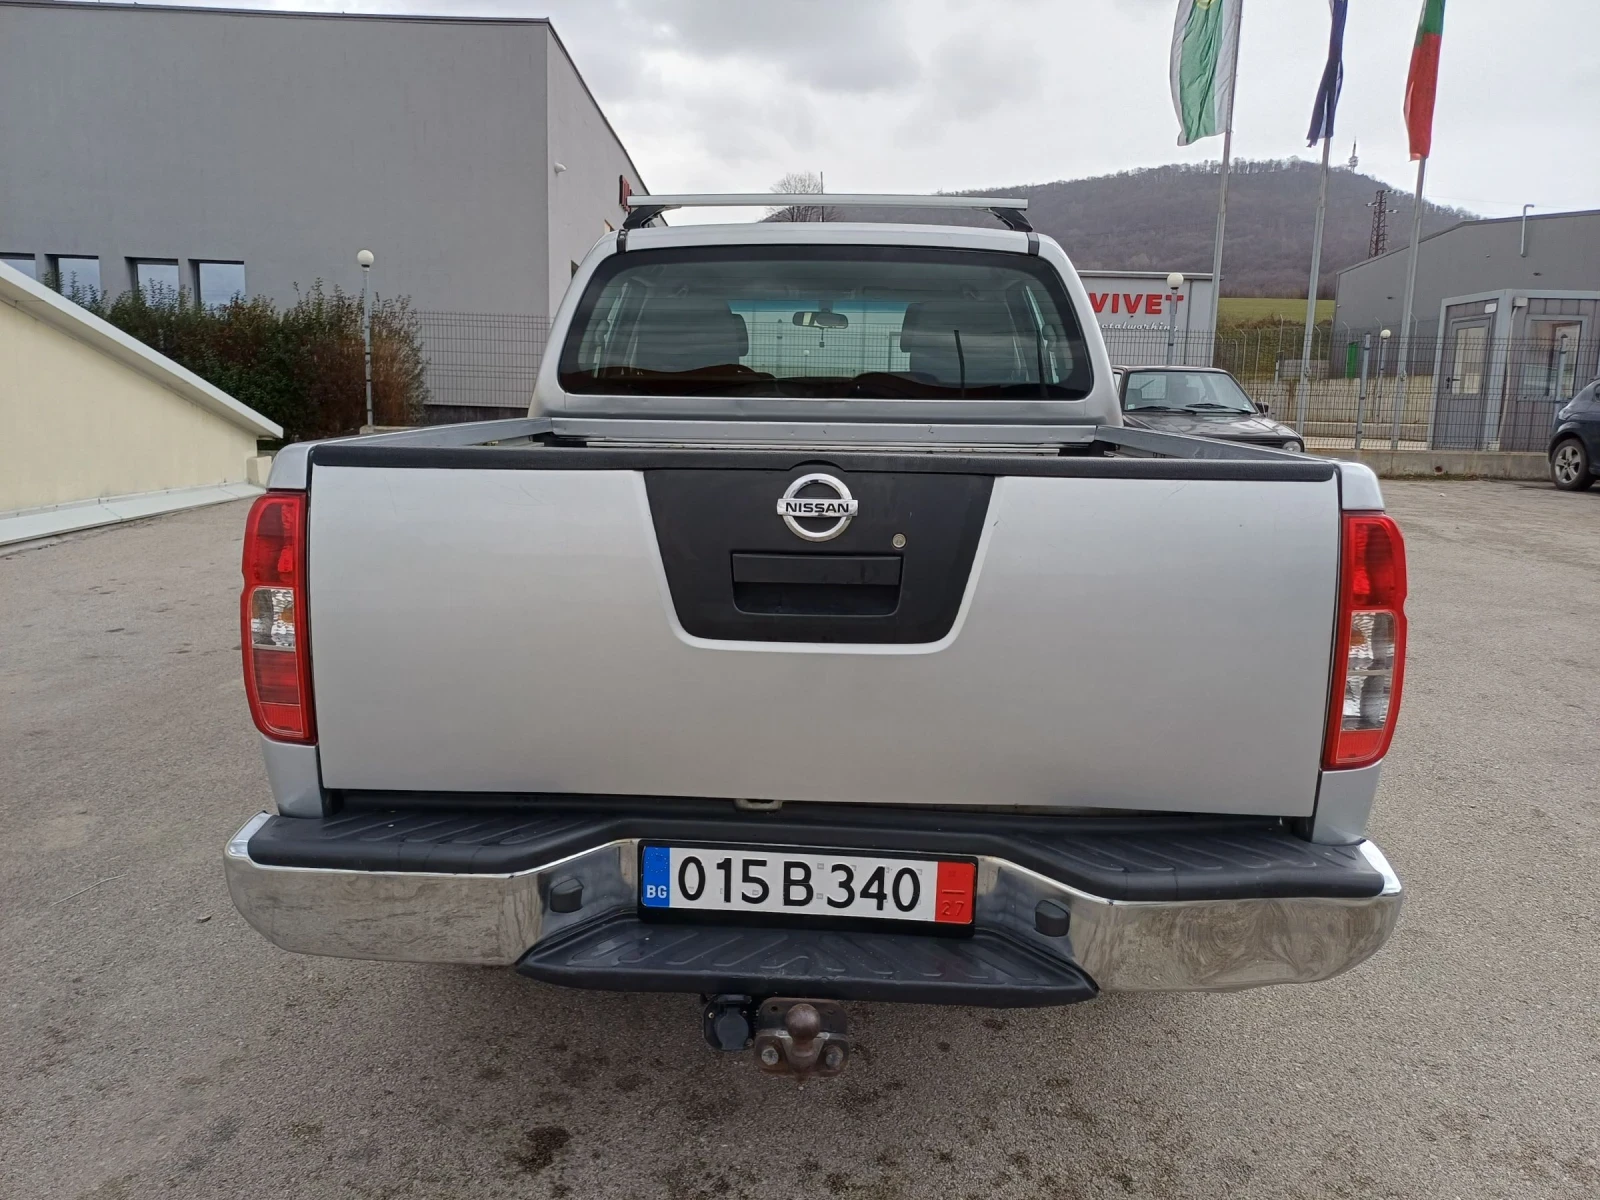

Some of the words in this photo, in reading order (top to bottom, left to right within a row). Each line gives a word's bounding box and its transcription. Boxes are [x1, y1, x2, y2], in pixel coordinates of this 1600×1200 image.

[785, 502, 849, 513] NISSAN
[646, 885, 667, 898] BG
[942, 901, 964, 916] 27
